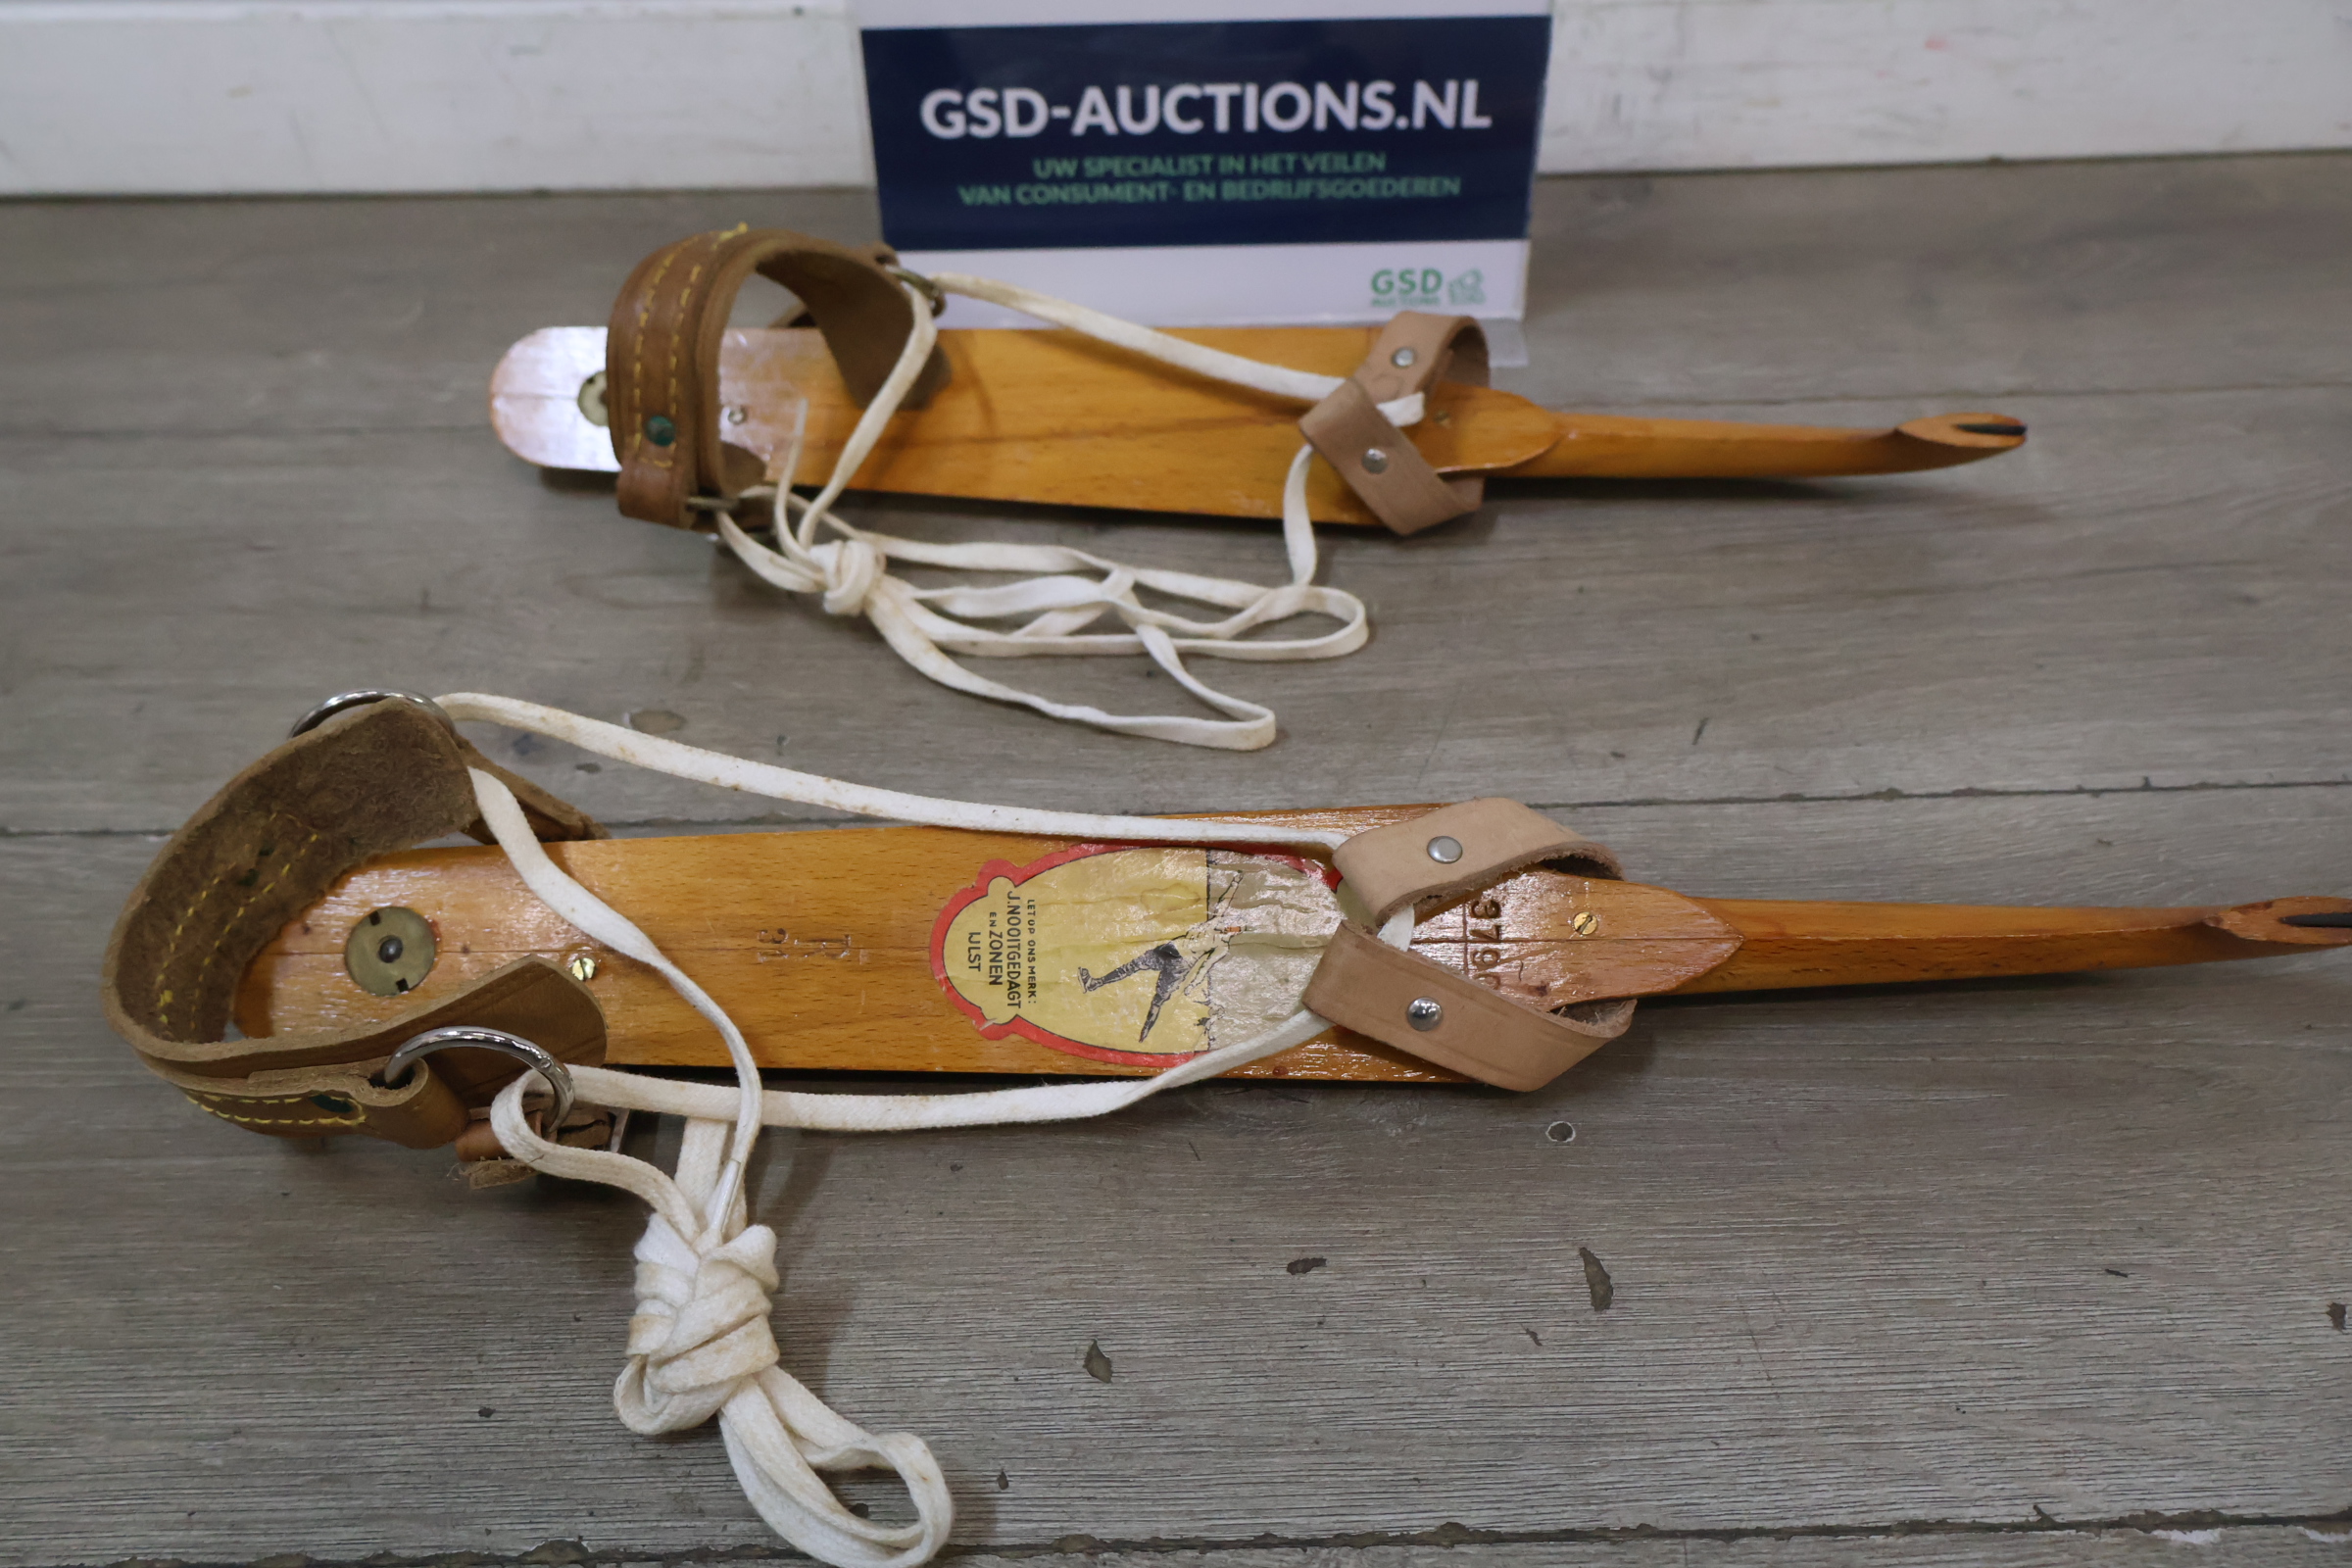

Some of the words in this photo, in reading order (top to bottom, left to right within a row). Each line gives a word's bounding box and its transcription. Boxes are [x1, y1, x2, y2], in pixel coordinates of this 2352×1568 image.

[920, 79, 1494, 140] GSD-AUCTIONS.NL
[1033, 159, 1078, 179] UW
[1083, 154, 1213, 177] SPECIALIST
[1218, 154, 1246, 173] IN
[1250, 153, 1299, 174] HET
[1302, 151, 1387, 173] VEILEN
[957, 185, 1011, 205] VAN
[1183, 179, 1216, 201] EN
[1221, 175, 1462, 201] BEDRIJFSGOEDEREN
[1370, 269, 1444, 295] GSD
[989, 911, 997, 927] EN
[1027, 899, 1036, 916] LET
[1027, 919, 1036, 934] OP
[988, 930, 1004, 986] ZONEN
[1006, 890, 1022, 1008] J.NOOITGEDAGT
[1027, 940, 1036, 963] ONS
